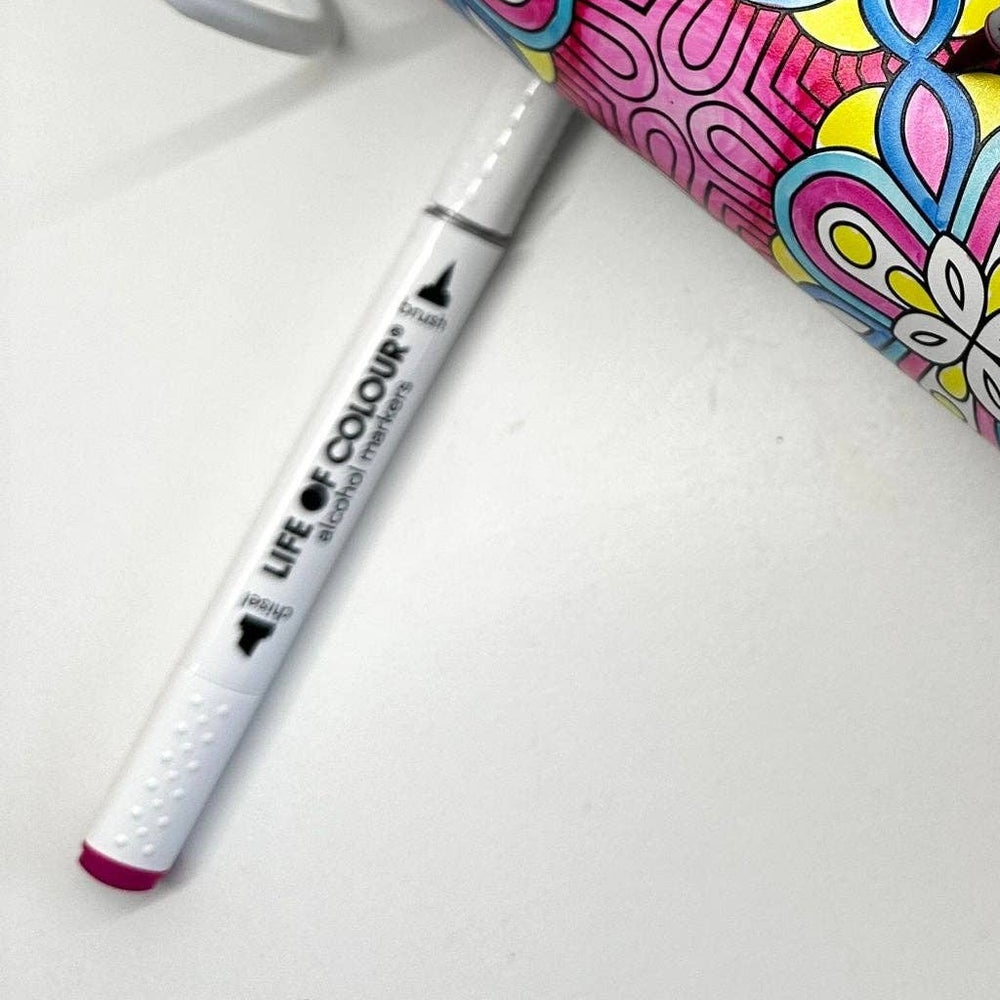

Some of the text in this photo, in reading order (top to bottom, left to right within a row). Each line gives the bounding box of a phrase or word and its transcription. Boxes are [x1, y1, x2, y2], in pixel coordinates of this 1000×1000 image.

[264, 516, 313, 579] LIFE
[301, 467, 337, 512] OF
[318, 380, 414, 545] alcohol markers
